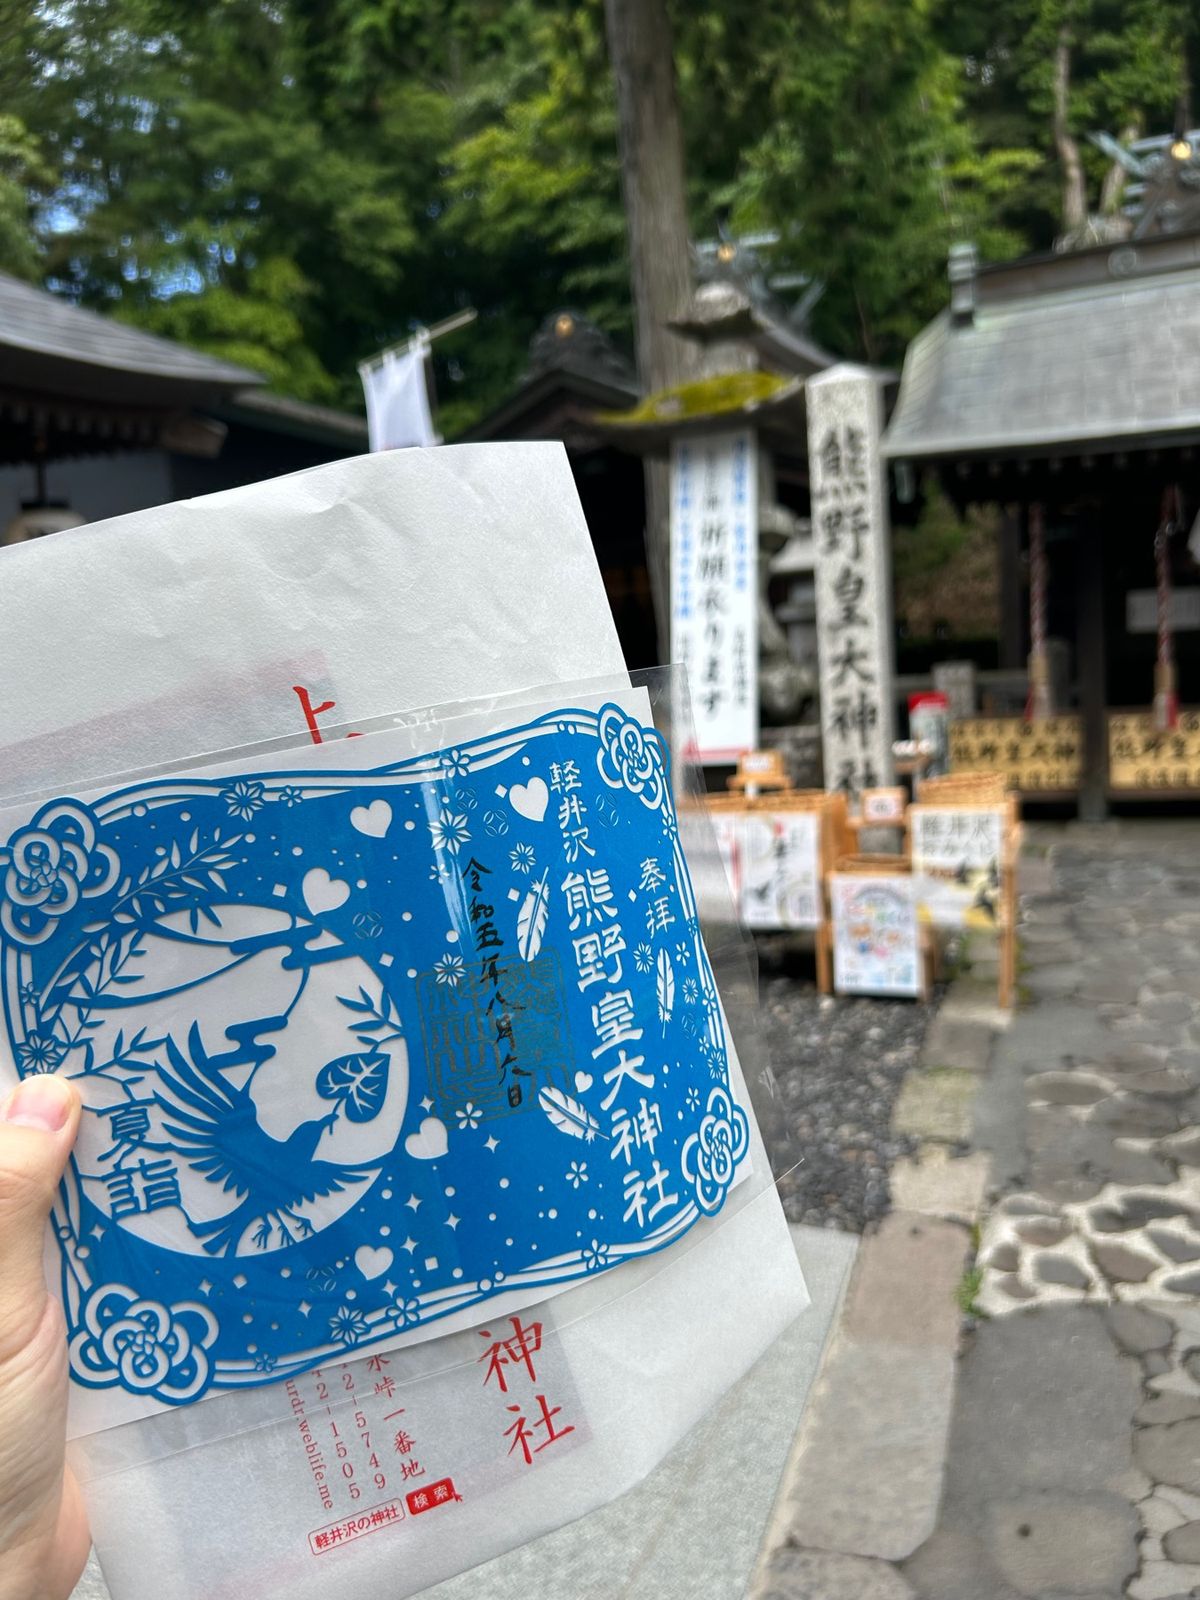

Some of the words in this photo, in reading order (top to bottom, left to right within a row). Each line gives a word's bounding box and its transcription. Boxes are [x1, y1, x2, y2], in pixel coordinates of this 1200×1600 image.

[639, 857, 676, 939] 奉拝
[477, 1316, 576, 1465] 神社
[314, 1504, 400, 1551] 軽井沢の神社
[414, 1484, 451, 1510] 検索
